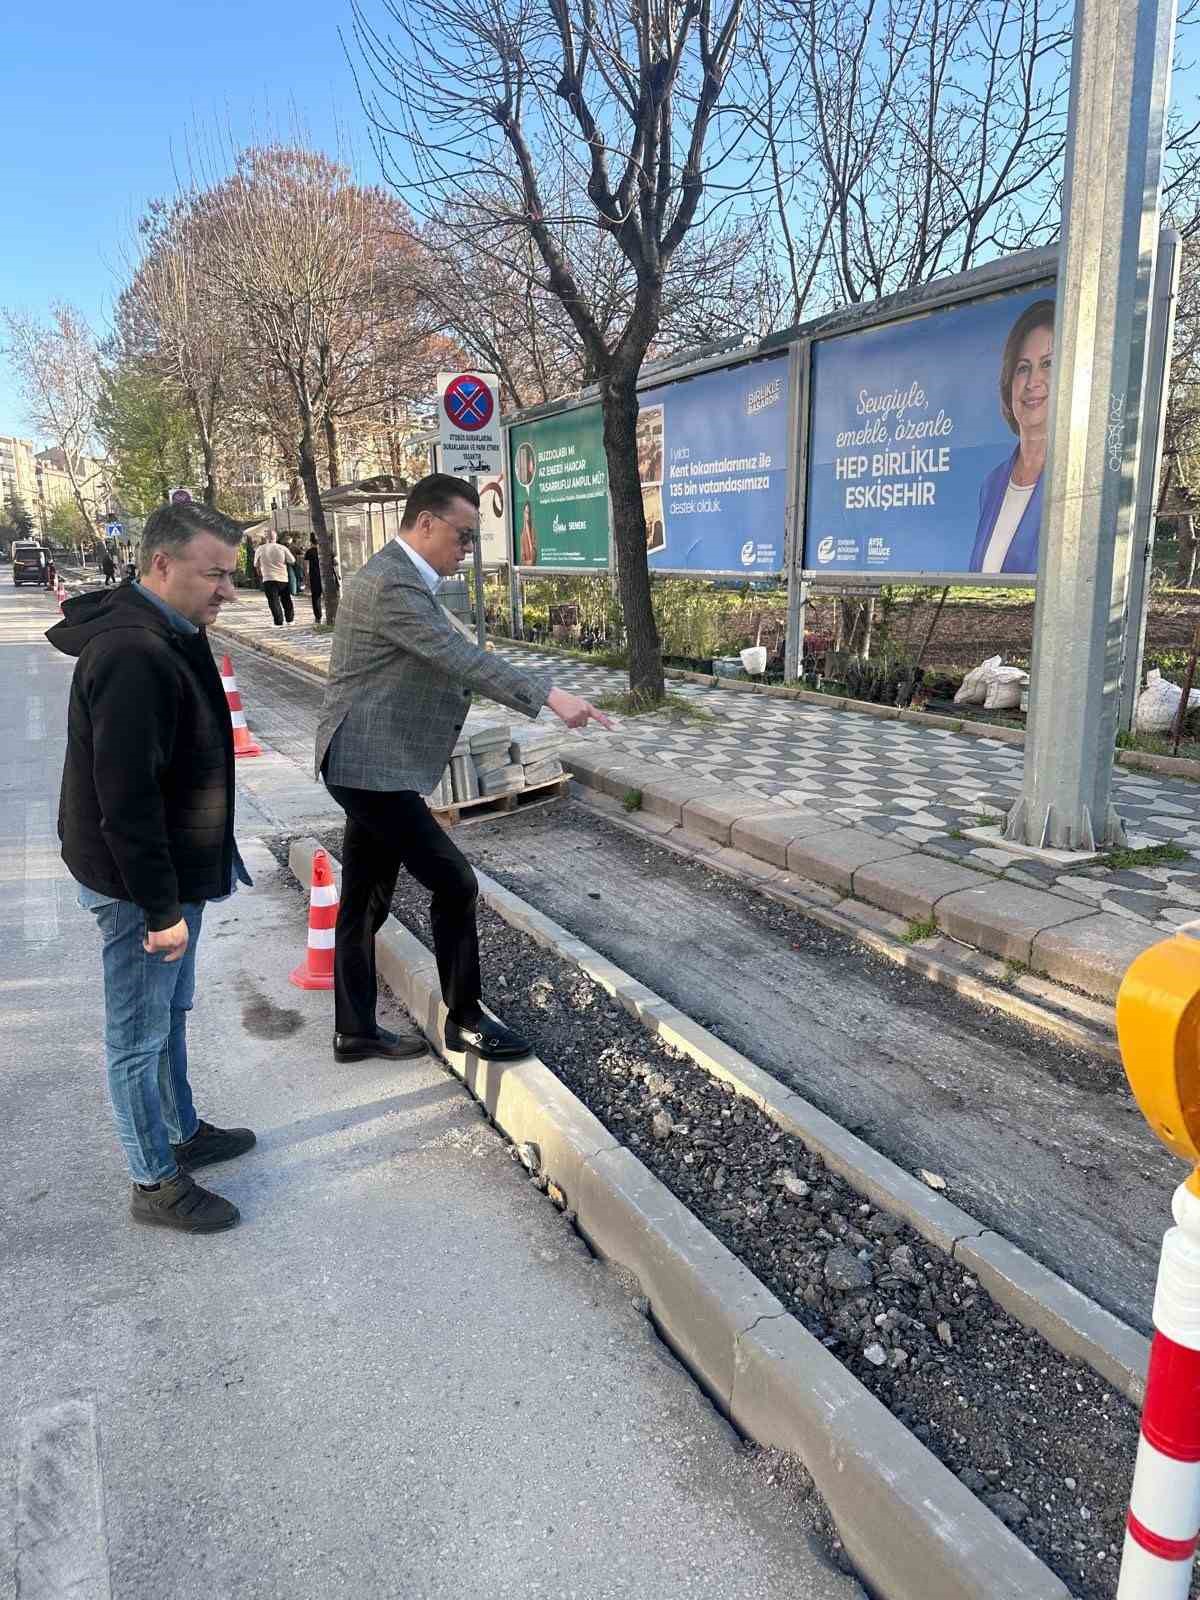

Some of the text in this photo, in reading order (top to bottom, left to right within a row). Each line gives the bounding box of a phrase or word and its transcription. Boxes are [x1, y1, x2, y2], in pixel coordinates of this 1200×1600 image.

[856, 381, 929, 421] Sevgiyle,
[836, 409, 953, 448] emekle, özenle
[670, 452, 772, 478] Kent lokantalarımız ile
[836, 445, 951, 480] HEP BİRLİKLE
[670, 476, 770, 497] 135 bin vatandaşımıza
[845, 475, 936, 511] ESKİŞEHİR
[670, 500, 697, 514] destek
